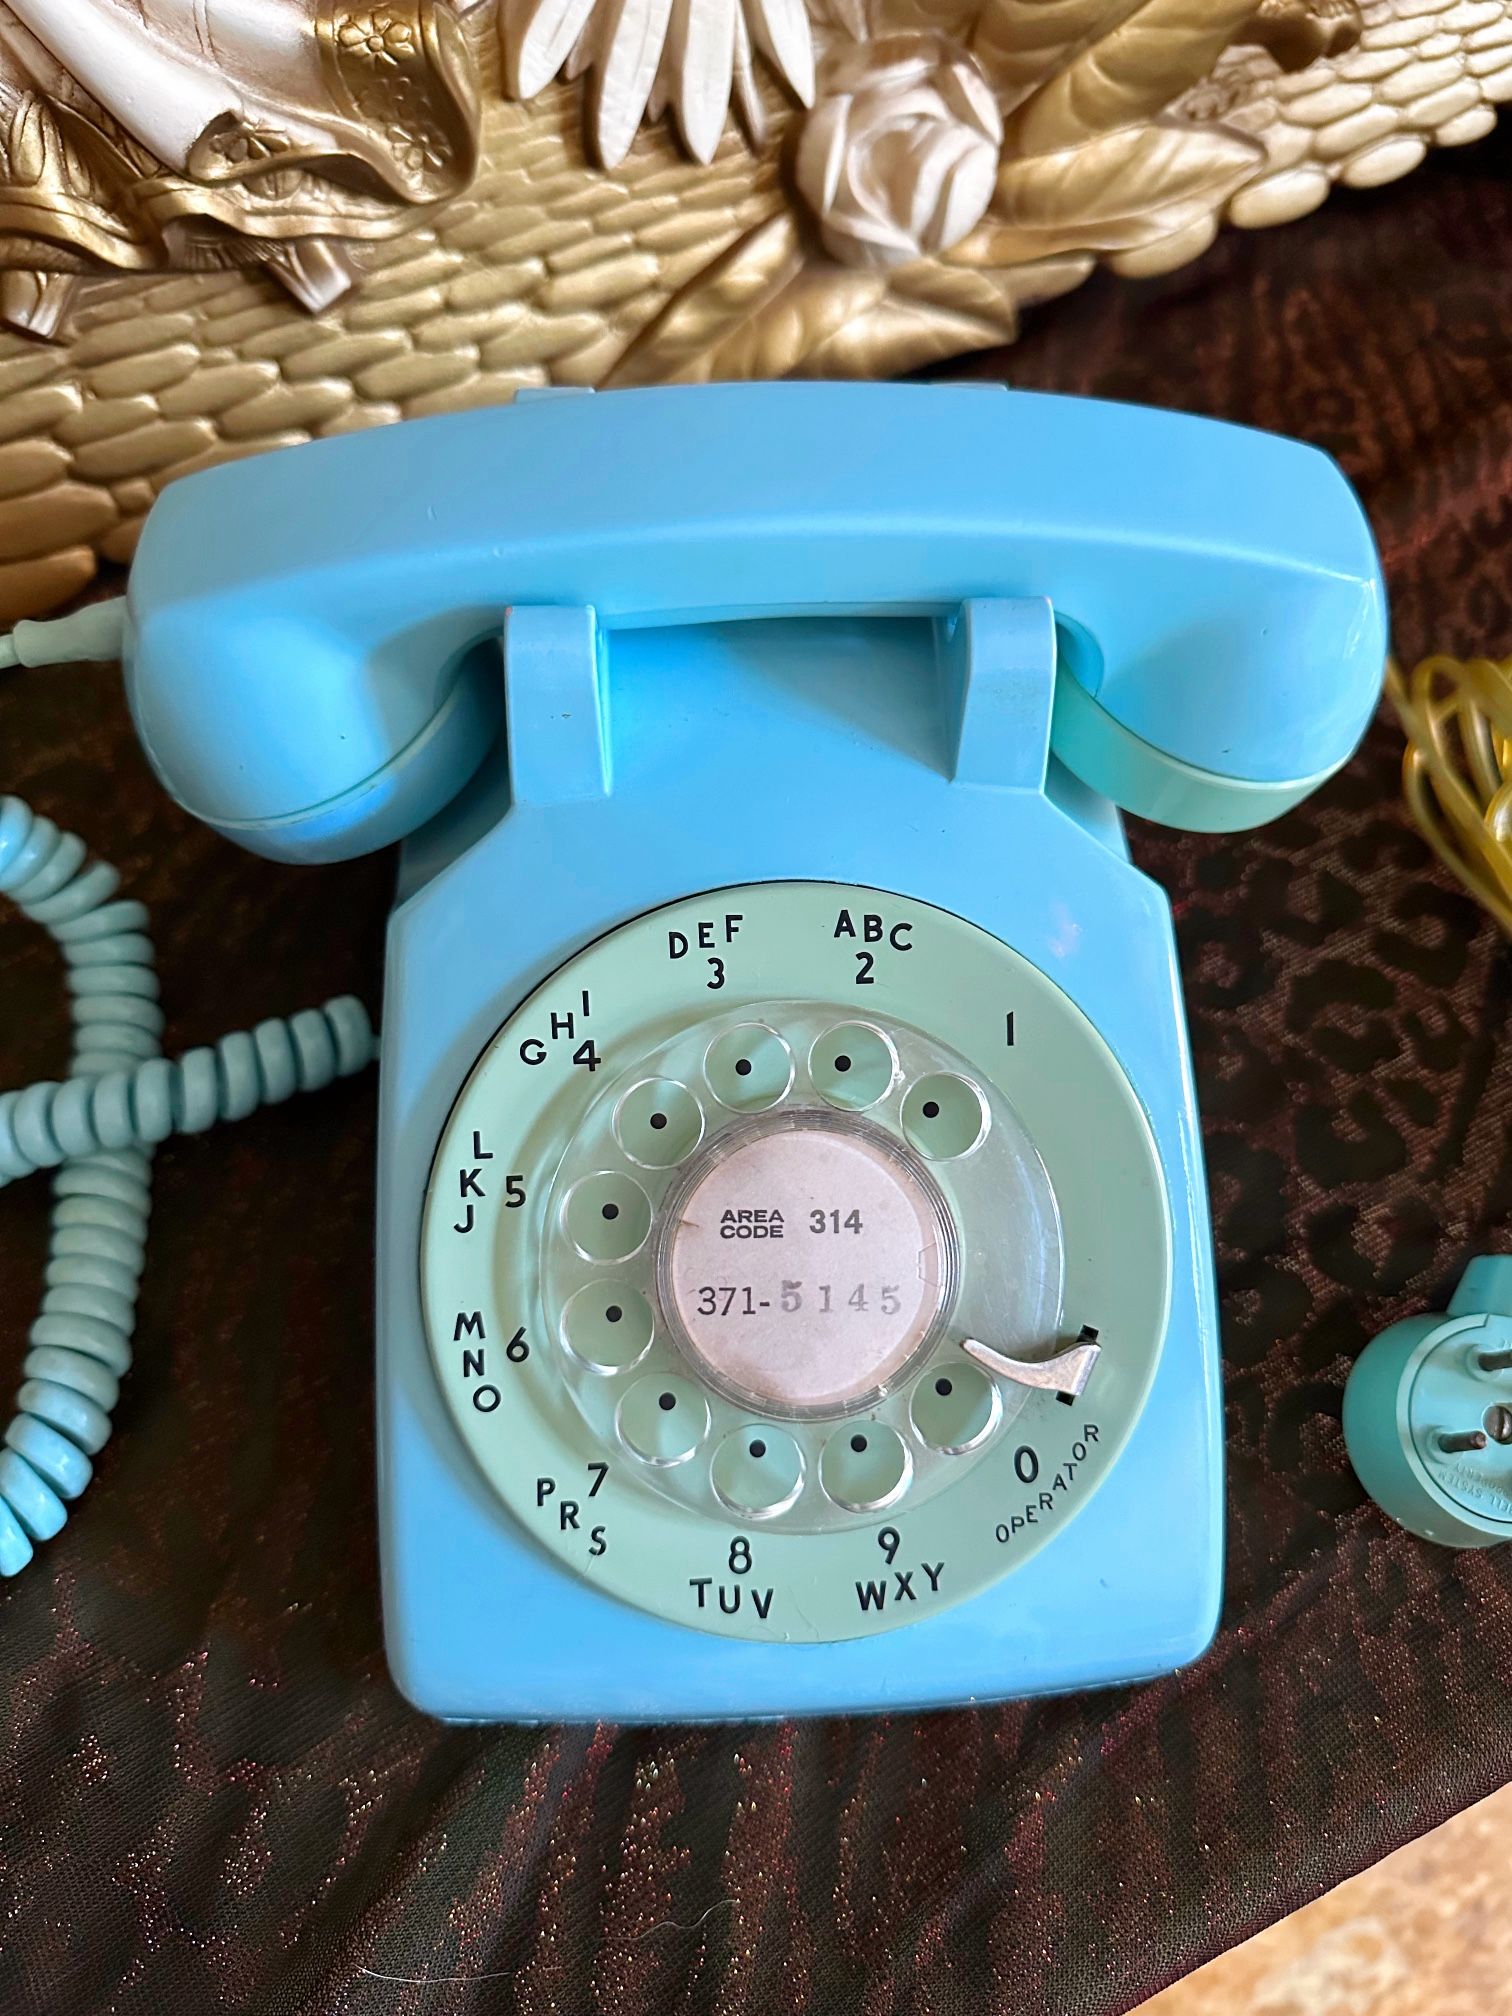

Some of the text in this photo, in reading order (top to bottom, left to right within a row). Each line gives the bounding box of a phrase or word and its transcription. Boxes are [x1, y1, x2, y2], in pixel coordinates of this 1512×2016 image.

[668, 914, 743, 960] DEF
[833, 909, 913, 952] ABC
[707, 957, 725, 990] 3
[855, 951, 875, 985] 2
[572, 1039, 602, 1073] 4
[504, 1174, 526, 1209] 5
[719, 1224, 784, 1239] CODE
[720, 1209, 785, 1224] AREA
[809, 1209, 863, 1234] 314
[505, 1326, 530, 1363] 6
[587, 1462, 609, 1497] 7
[995, 1424, 1099, 1544] OPERATOR
[536, 1478, 608, 1556] PRS
[728, 1536, 753, 1575] 8
[877, 1526, 901, 1566] 9
[689, 1578, 774, 1619] TUV
[855, 1562, 945, 1611] WXY
